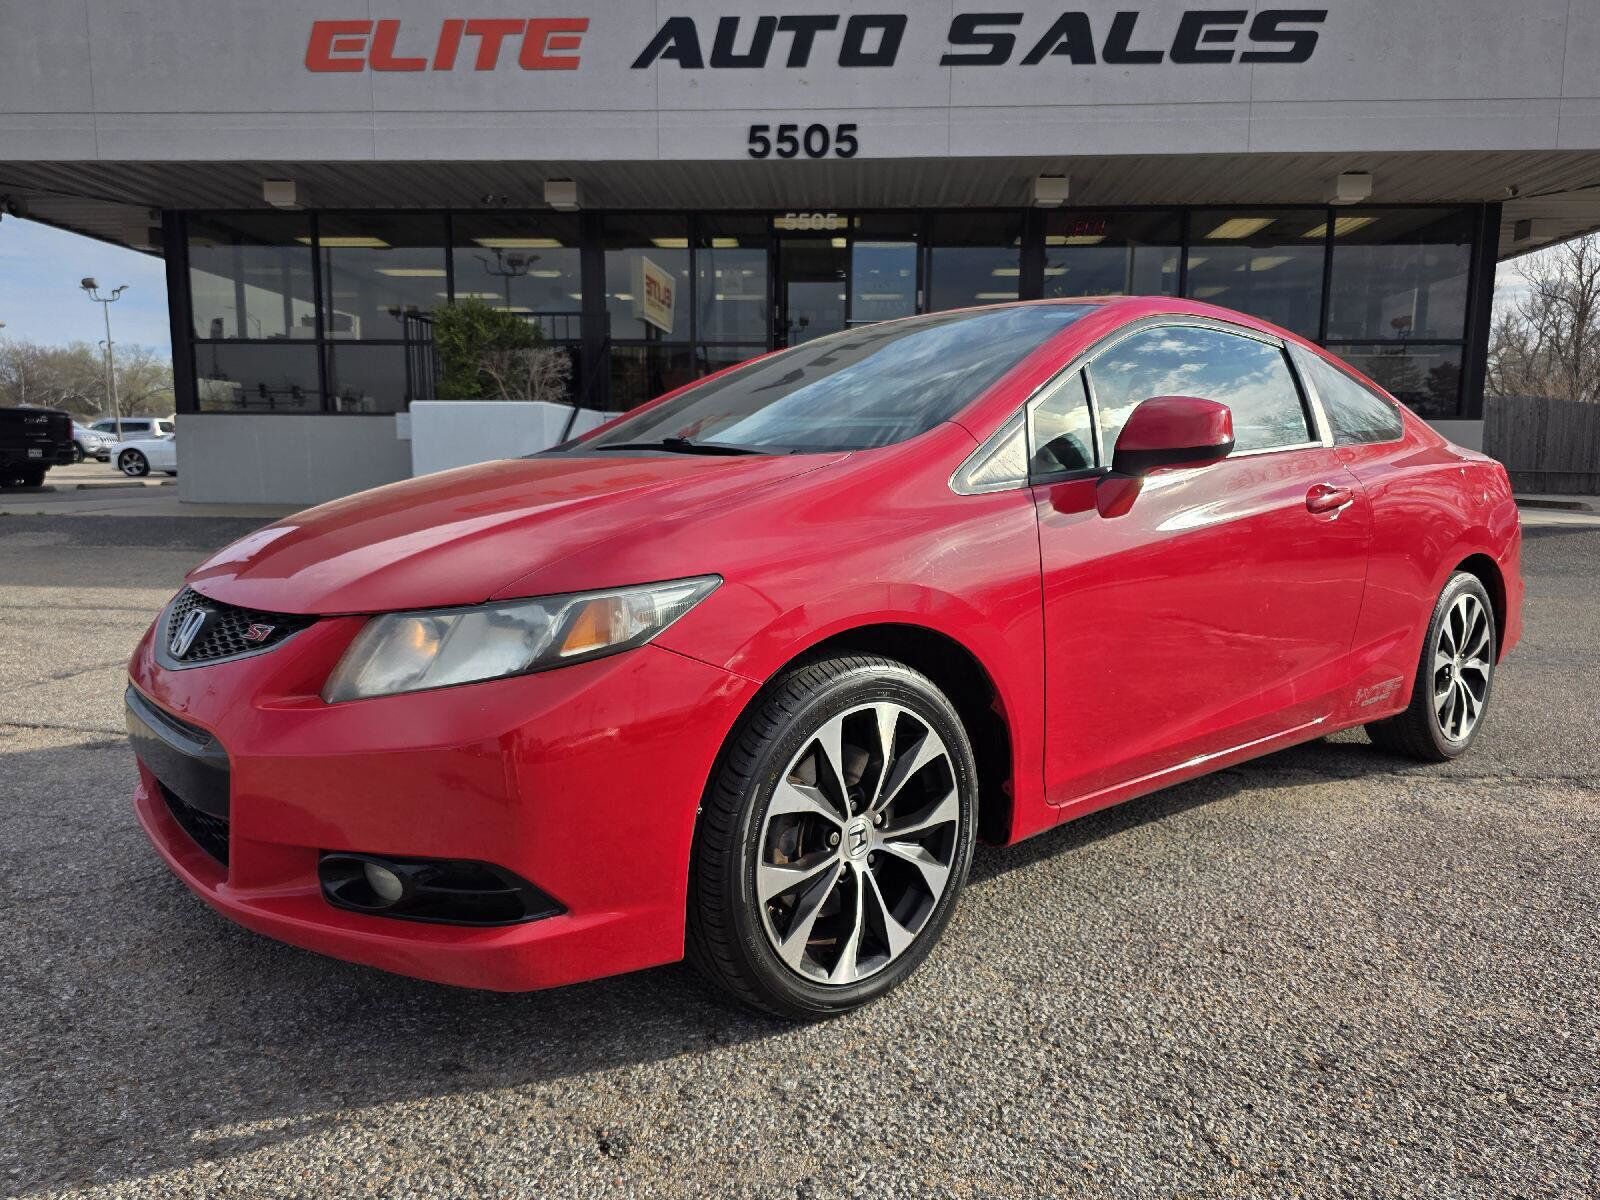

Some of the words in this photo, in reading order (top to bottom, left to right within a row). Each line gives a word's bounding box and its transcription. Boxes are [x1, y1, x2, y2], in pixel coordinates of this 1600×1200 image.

[305, 18, 589, 72] ELITE
[631, 14, 908, 71] AUTO
[940, 10, 1328, 67] SALES
[748, 123, 859, 159] 5505
[784, 213, 838, 230] 5505
